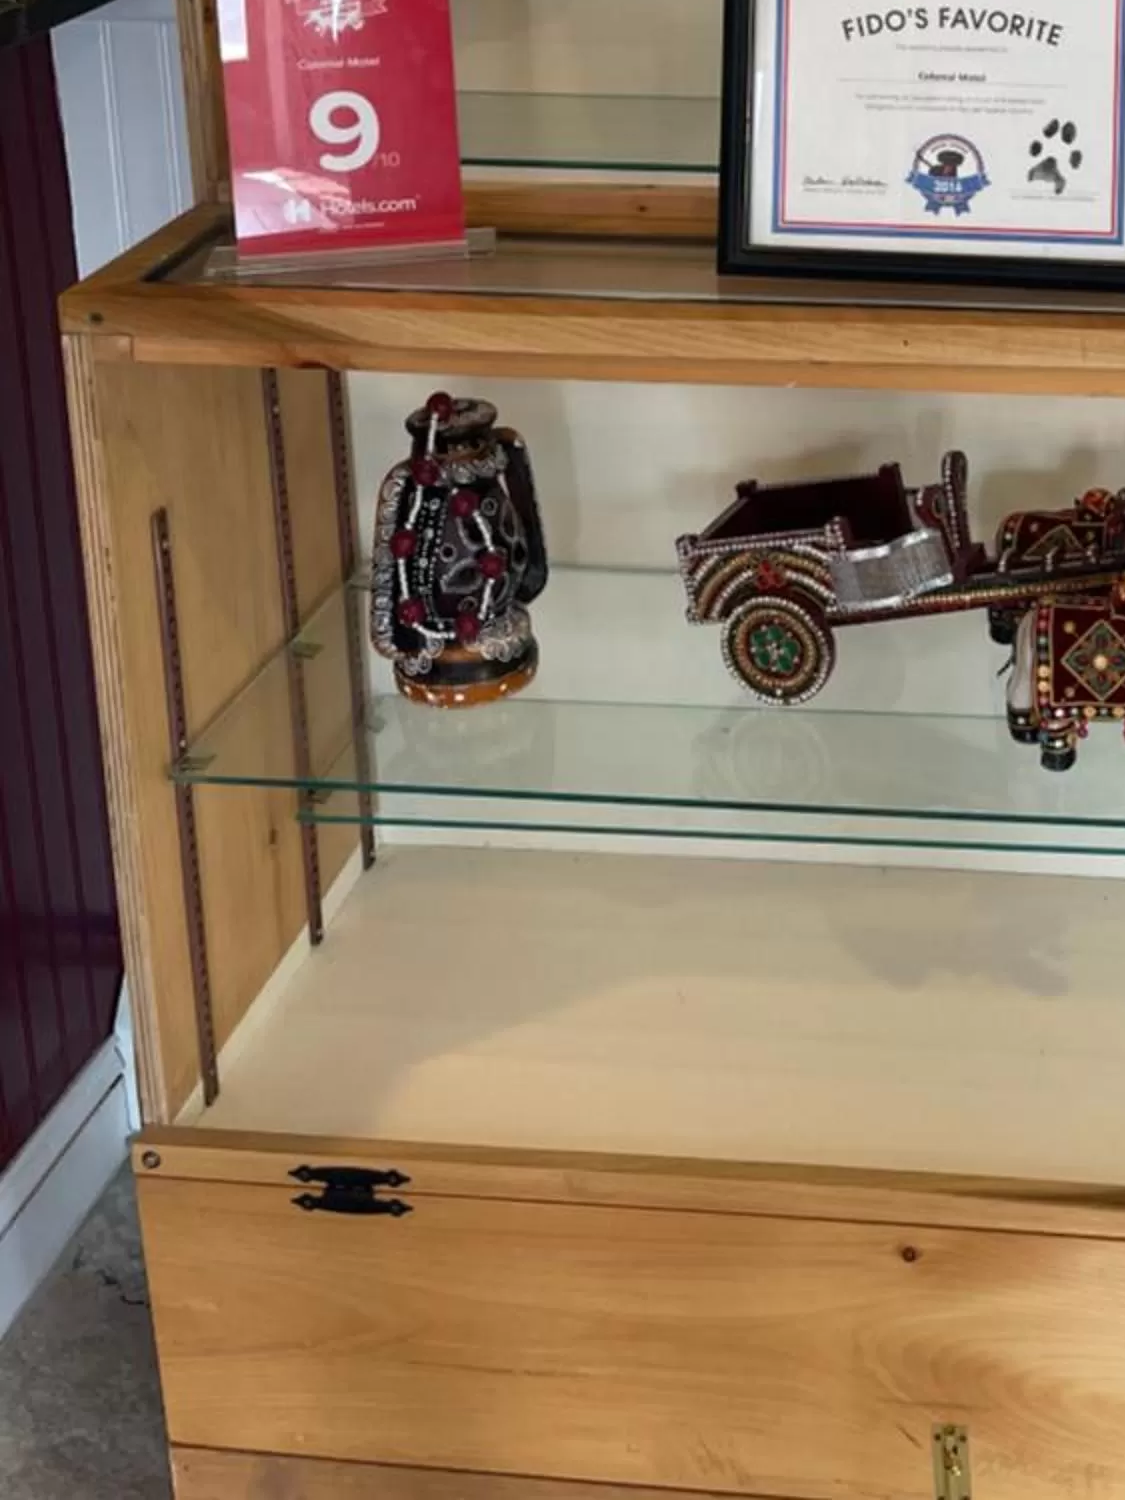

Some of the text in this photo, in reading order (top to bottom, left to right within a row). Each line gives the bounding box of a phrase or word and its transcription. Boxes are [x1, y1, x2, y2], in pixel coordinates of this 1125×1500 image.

[841, 7, 1064, 46] FIDO'S FAVORITE
[309, 90, 380, 172] 9
[321, 196, 417, 216] Hotels.com
